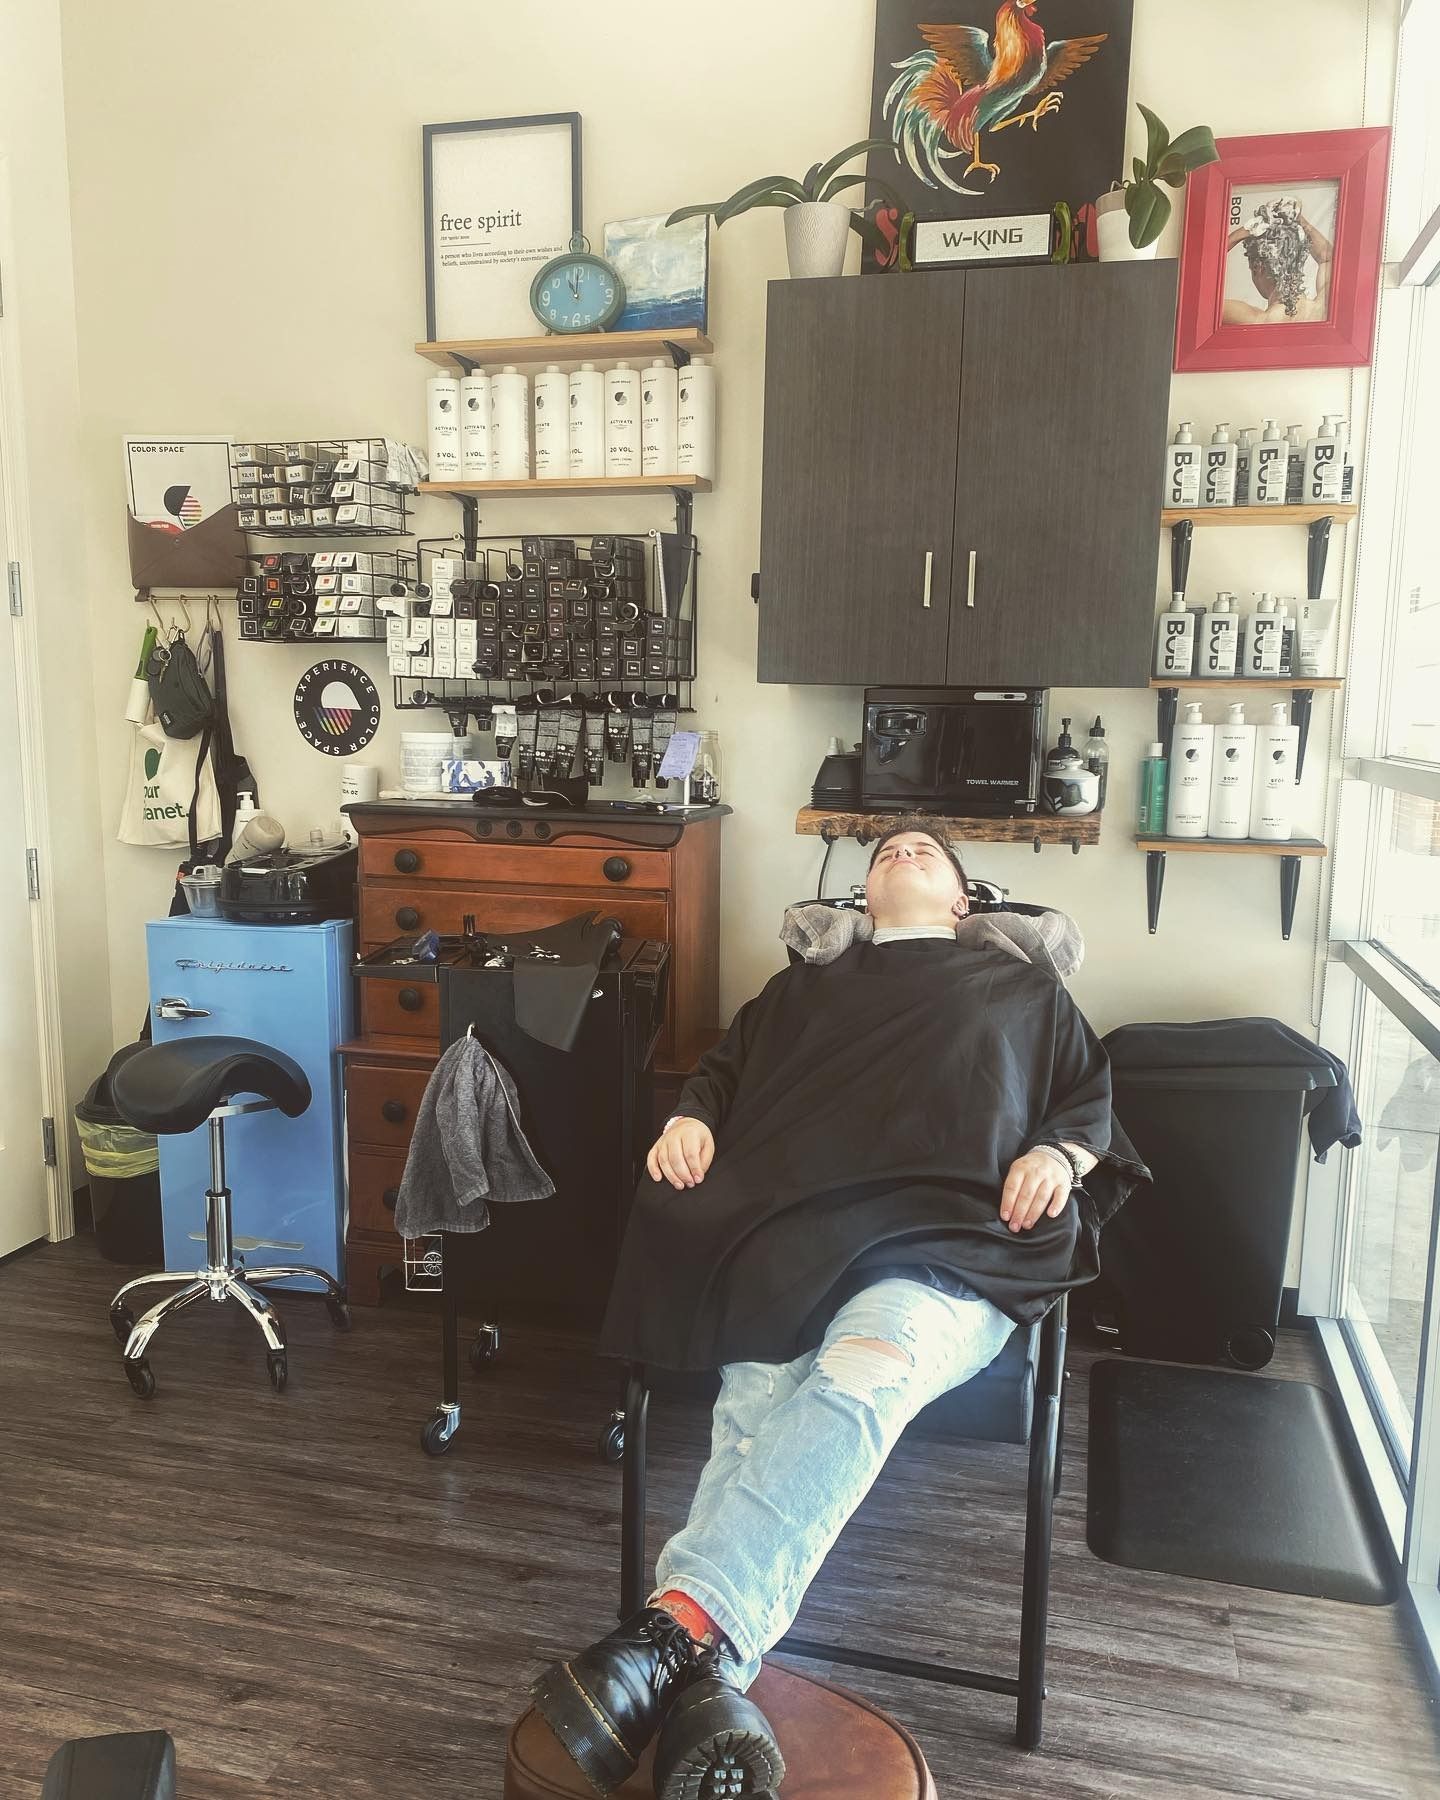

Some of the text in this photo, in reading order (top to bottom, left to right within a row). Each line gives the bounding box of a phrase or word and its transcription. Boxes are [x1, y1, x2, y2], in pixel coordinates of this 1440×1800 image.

[1230, 197, 1241, 226] BOB
[440, 209, 522, 233] free spirit
[942, 227, 1023, 251] W-KING
[552, 278, 560, 289] 10
[542, 290, 551, 306] 9
[604, 288, 614, 305] 3
[550, 309, 557, 320] 8
[562, 315, 568, 327] 7
[572, 312, 580, 327] 6
[584, 314, 591, 324] 5
[295, 661, 375, 702] EXPERIENCE
[349, 705, 379, 752] COLOR
[298, 721, 341, 755] SPACE
[175, 959, 294, 973] Frigidaire
